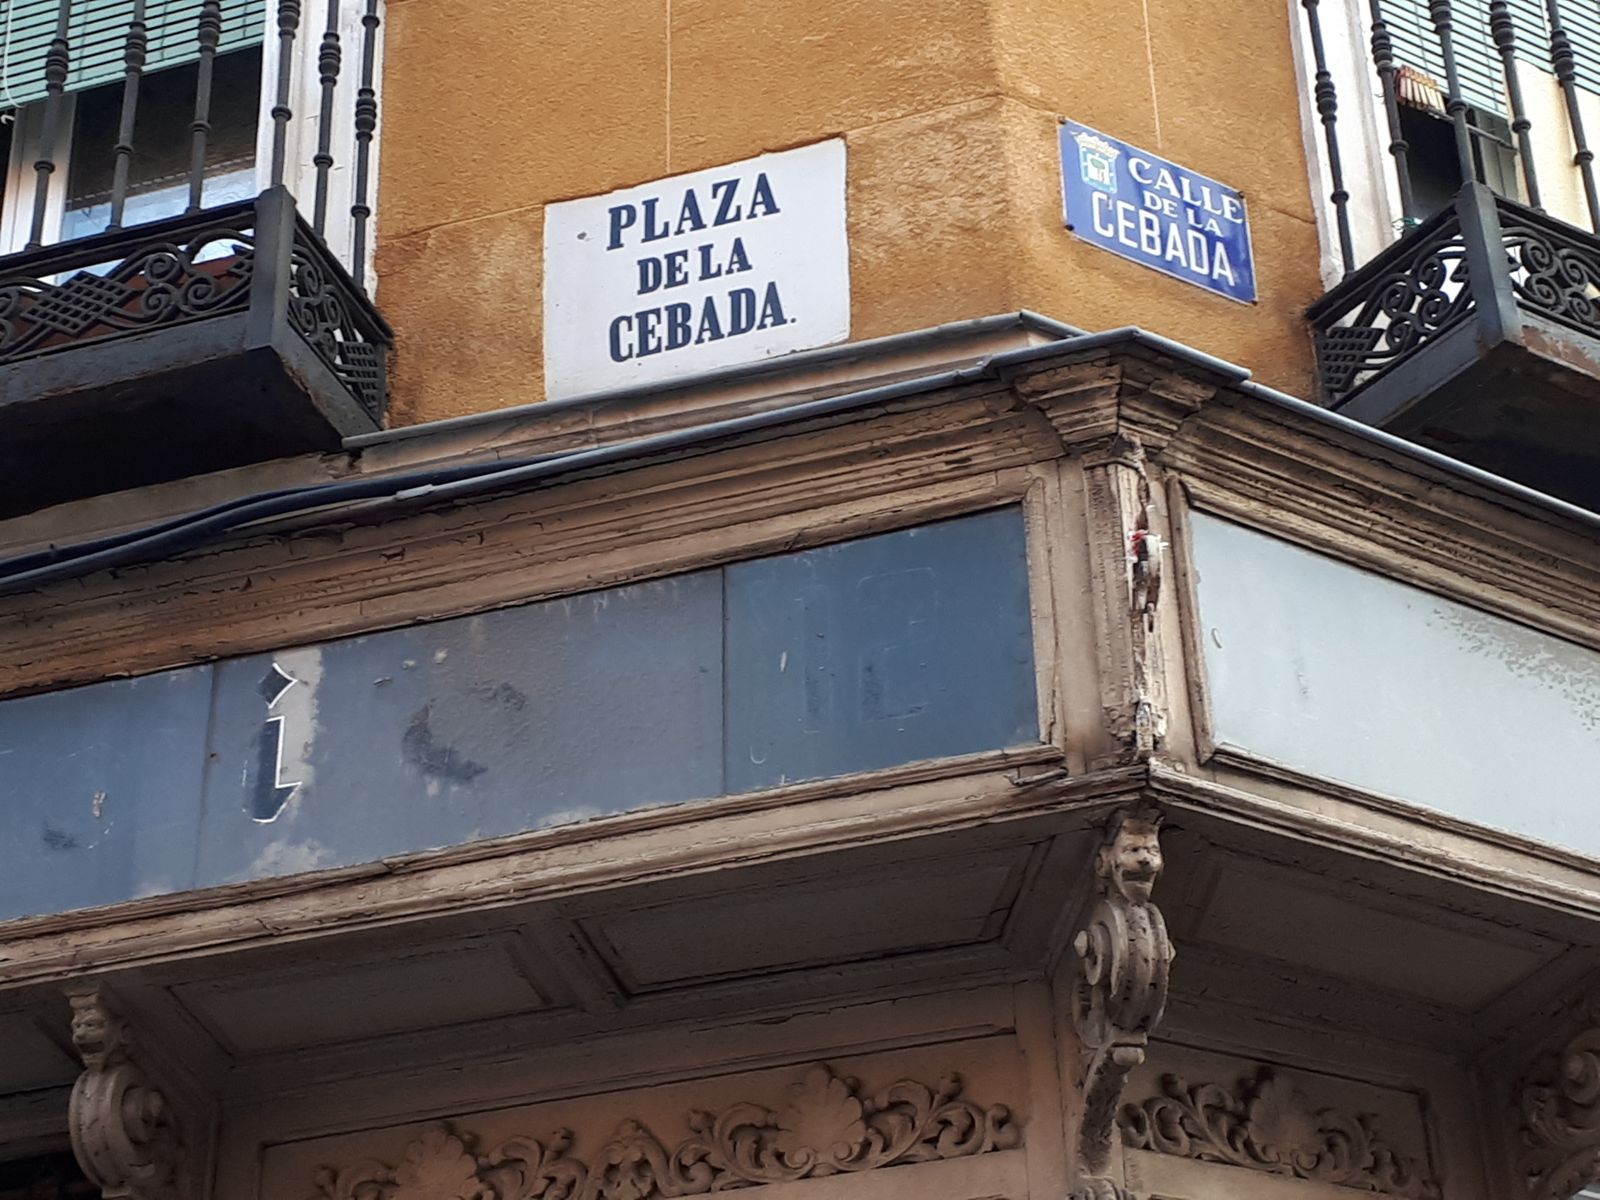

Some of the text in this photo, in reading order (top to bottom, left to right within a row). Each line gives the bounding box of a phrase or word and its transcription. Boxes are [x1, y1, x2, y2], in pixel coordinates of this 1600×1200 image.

[606, 172, 781, 251] PLAZA
[1127, 157, 1244, 225] CALLE
[1142, 190, 1225, 238] DE LA
[636, 236, 753, 296] DE LA
[1091, 190, 1236, 288] CEBADA
[609, 281, 797, 363] CEBADA.
